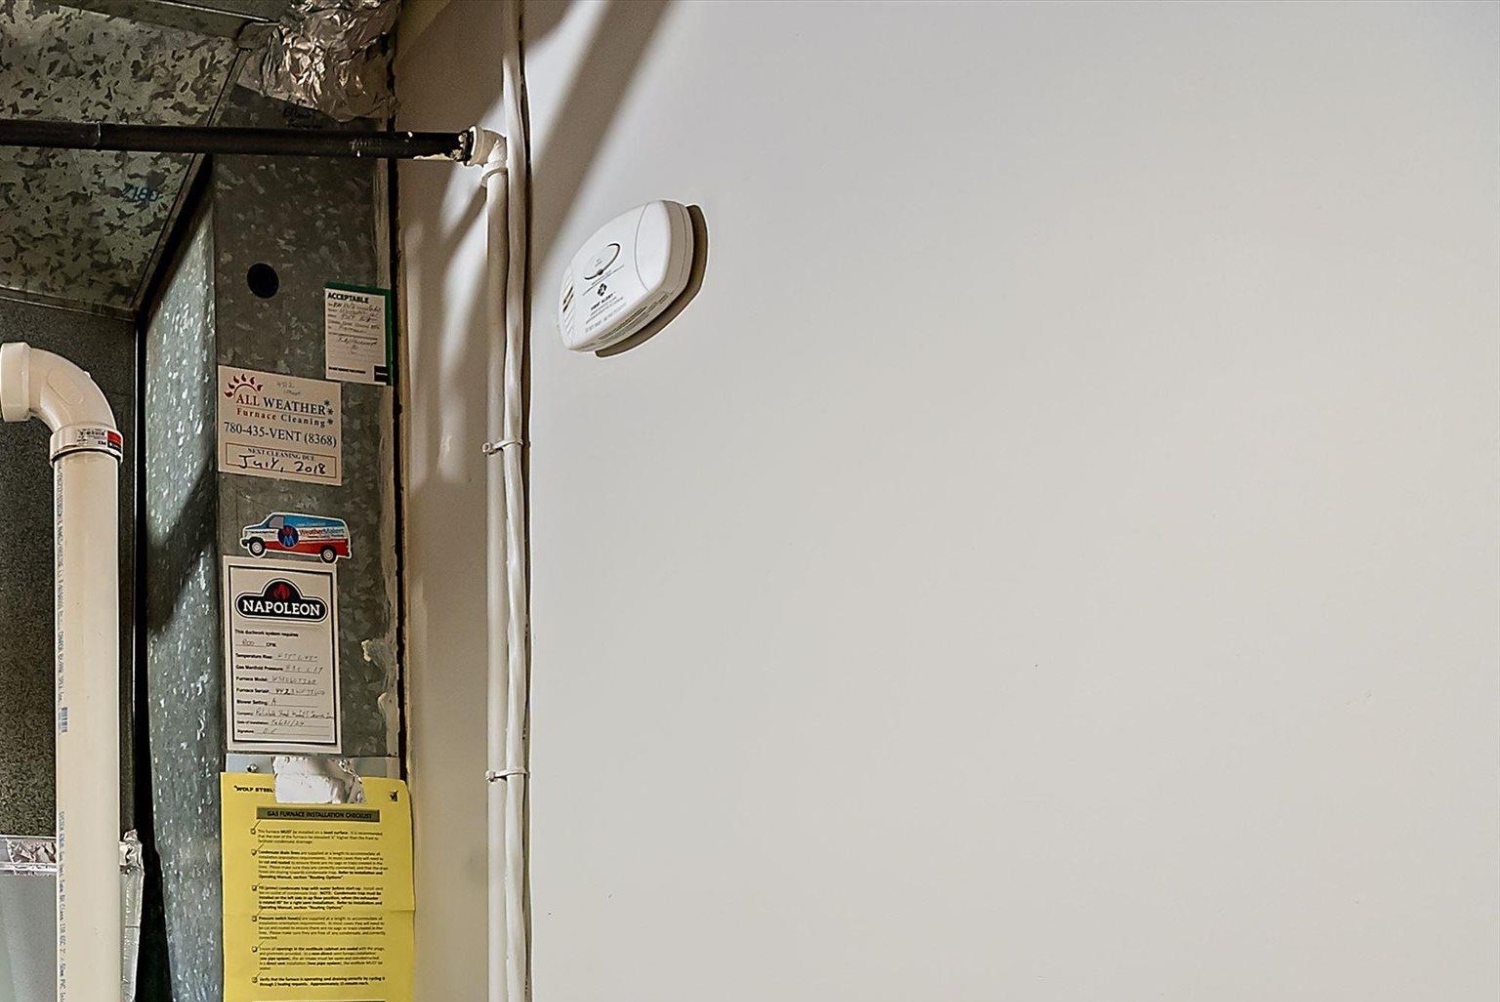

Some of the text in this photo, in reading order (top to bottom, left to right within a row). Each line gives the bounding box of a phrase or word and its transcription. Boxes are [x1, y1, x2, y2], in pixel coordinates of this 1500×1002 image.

[327, 292, 369, 304] ACCEPTABLE
[236, 394, 326, 415] ALL WEATHER
[236, 408, 326, 428] Furnace Cleaning
[223, 422, 337, 449] 780-435-VENT (8368)
[294, 461, 326, 474] 2018
[243, 600, 320, 616] NAPOLEON
